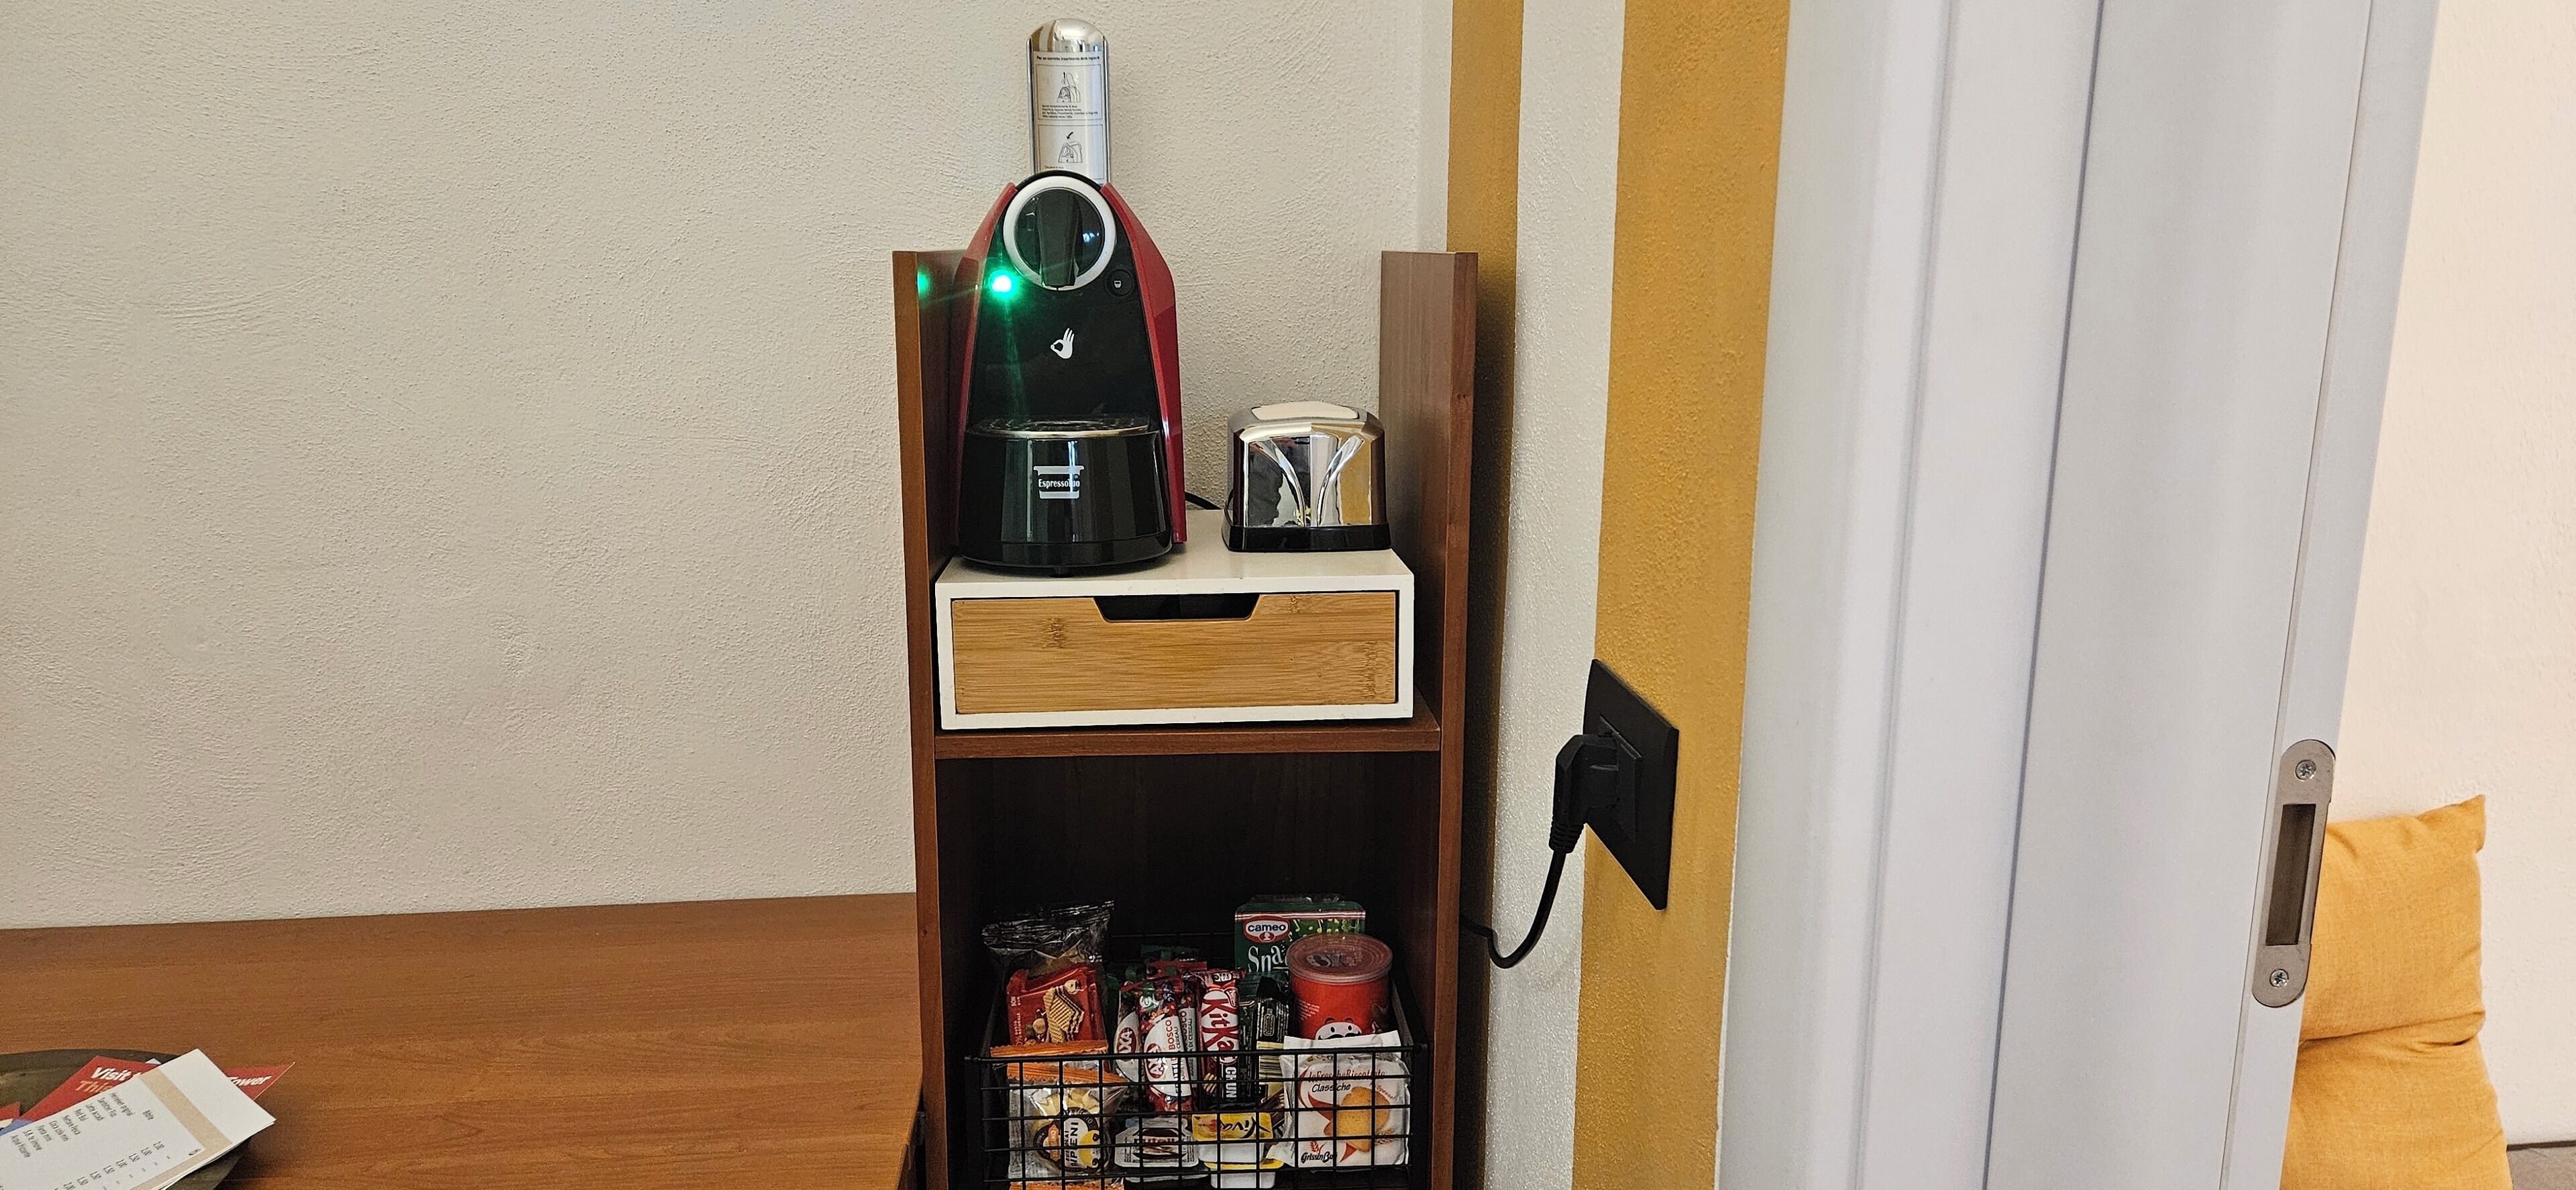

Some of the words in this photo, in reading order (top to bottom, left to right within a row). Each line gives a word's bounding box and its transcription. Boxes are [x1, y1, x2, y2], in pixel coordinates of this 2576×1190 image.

[1248, 924, 1286, 932] cameo
[1248, 946, 1288, 973] Sna
[1165, 1020, 1175, 1050] BOSCO
[1201, 998, 1238, 1061] KitKa
[91, 1067, 133, 1081] Visit
[1226, 1067, 1237, 1098] CHUN
[1311, 1082, 1351, 1093] Classche
[1070, 1122, 1079, 1167] RIPENI
[1301, 1151, 1338, 1164] GrissinBo
